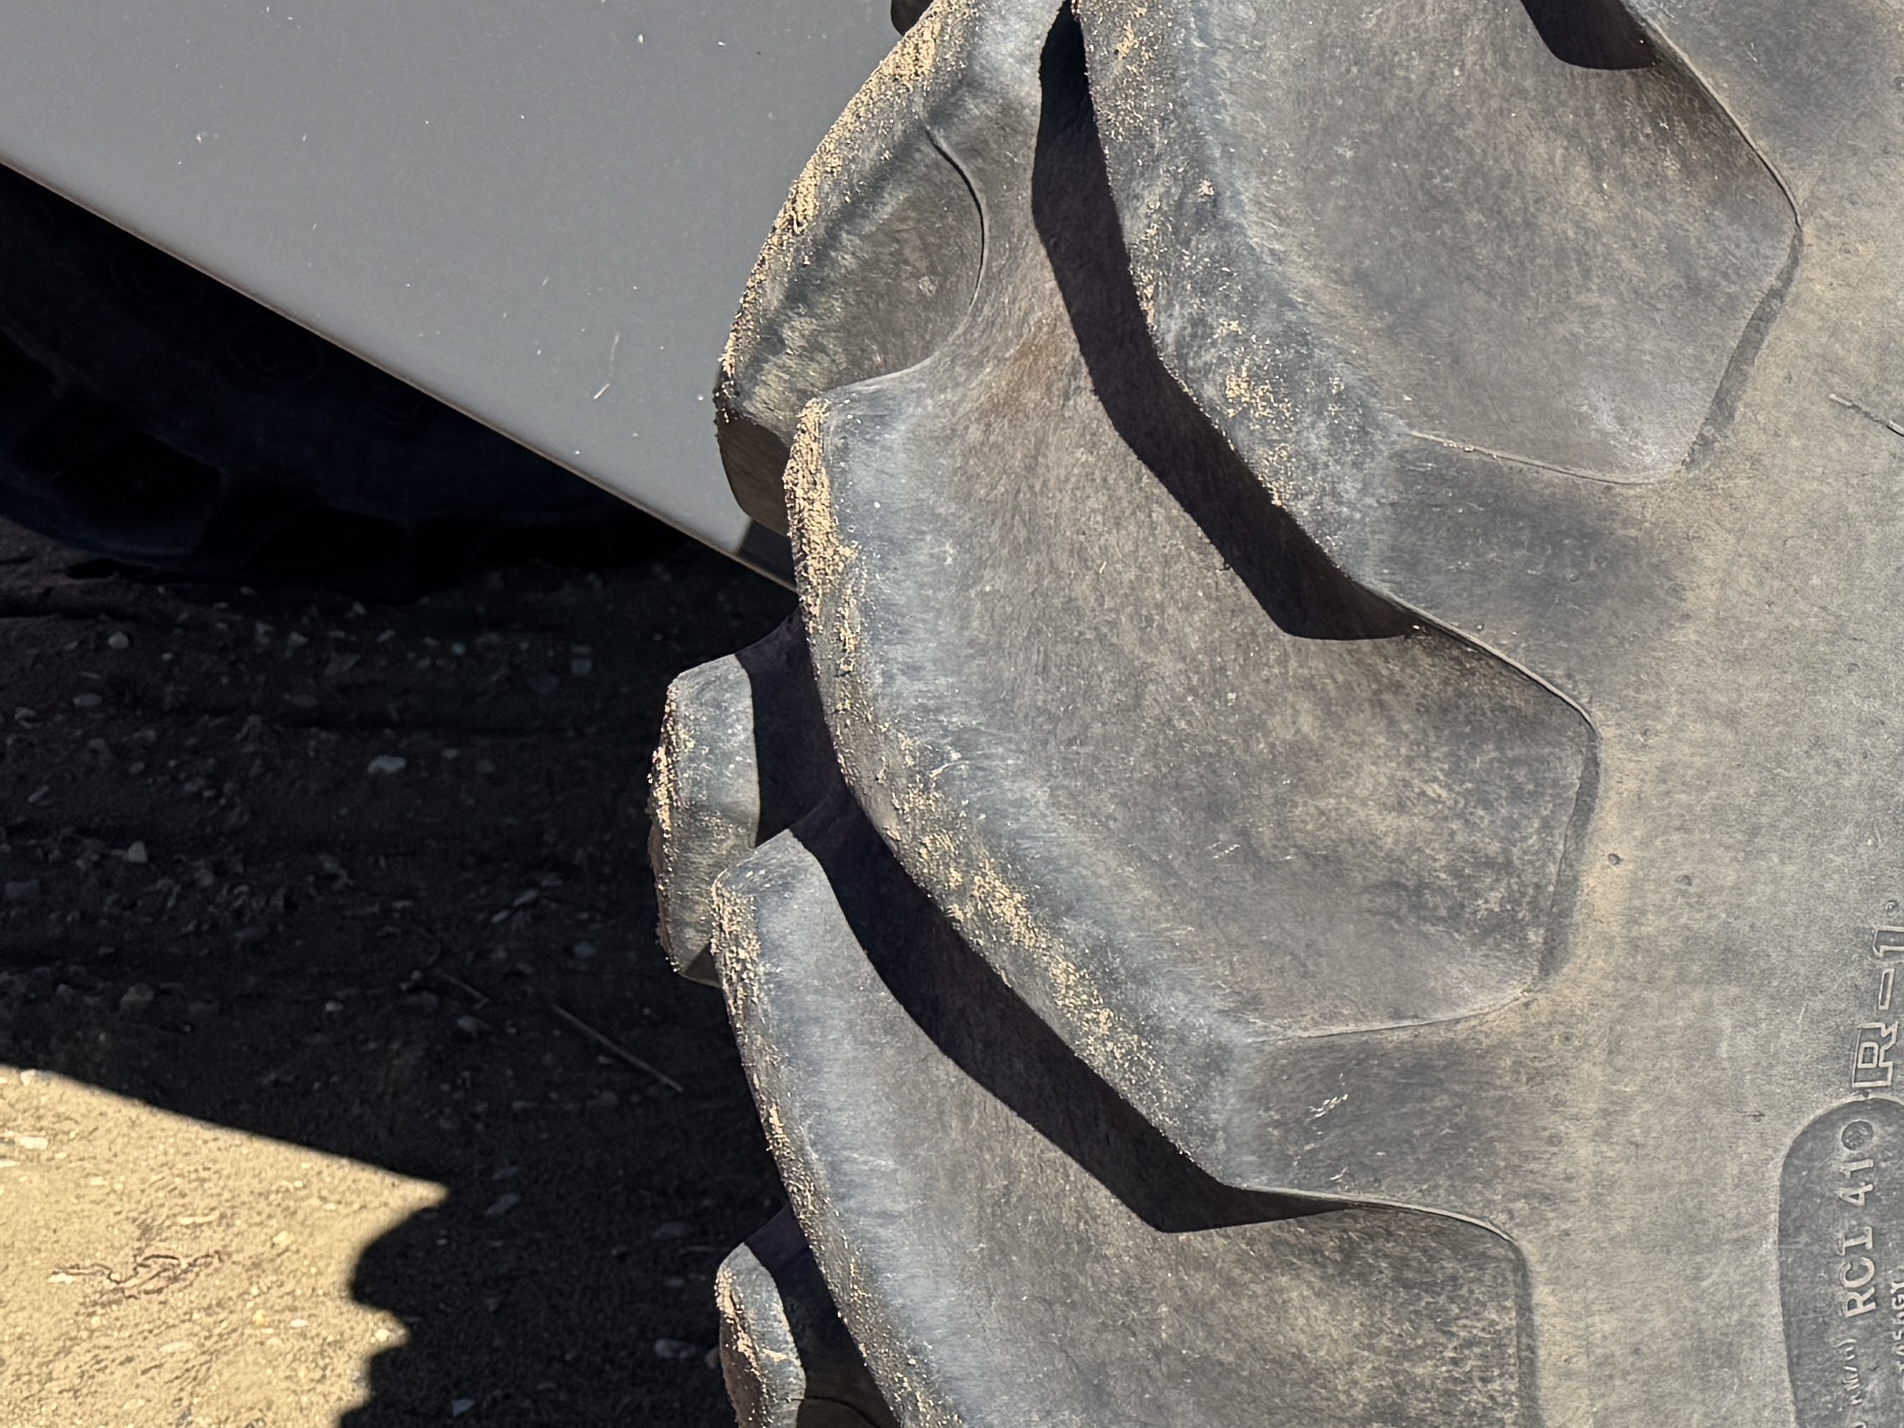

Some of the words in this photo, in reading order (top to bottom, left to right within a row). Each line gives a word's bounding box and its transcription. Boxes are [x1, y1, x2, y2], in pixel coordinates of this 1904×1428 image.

[1837, 1156, 1877, 1206] 41
[1835, 1224, 1880, 1318] RCI
[1833, 1335, 1868, 1406] KM/H)
